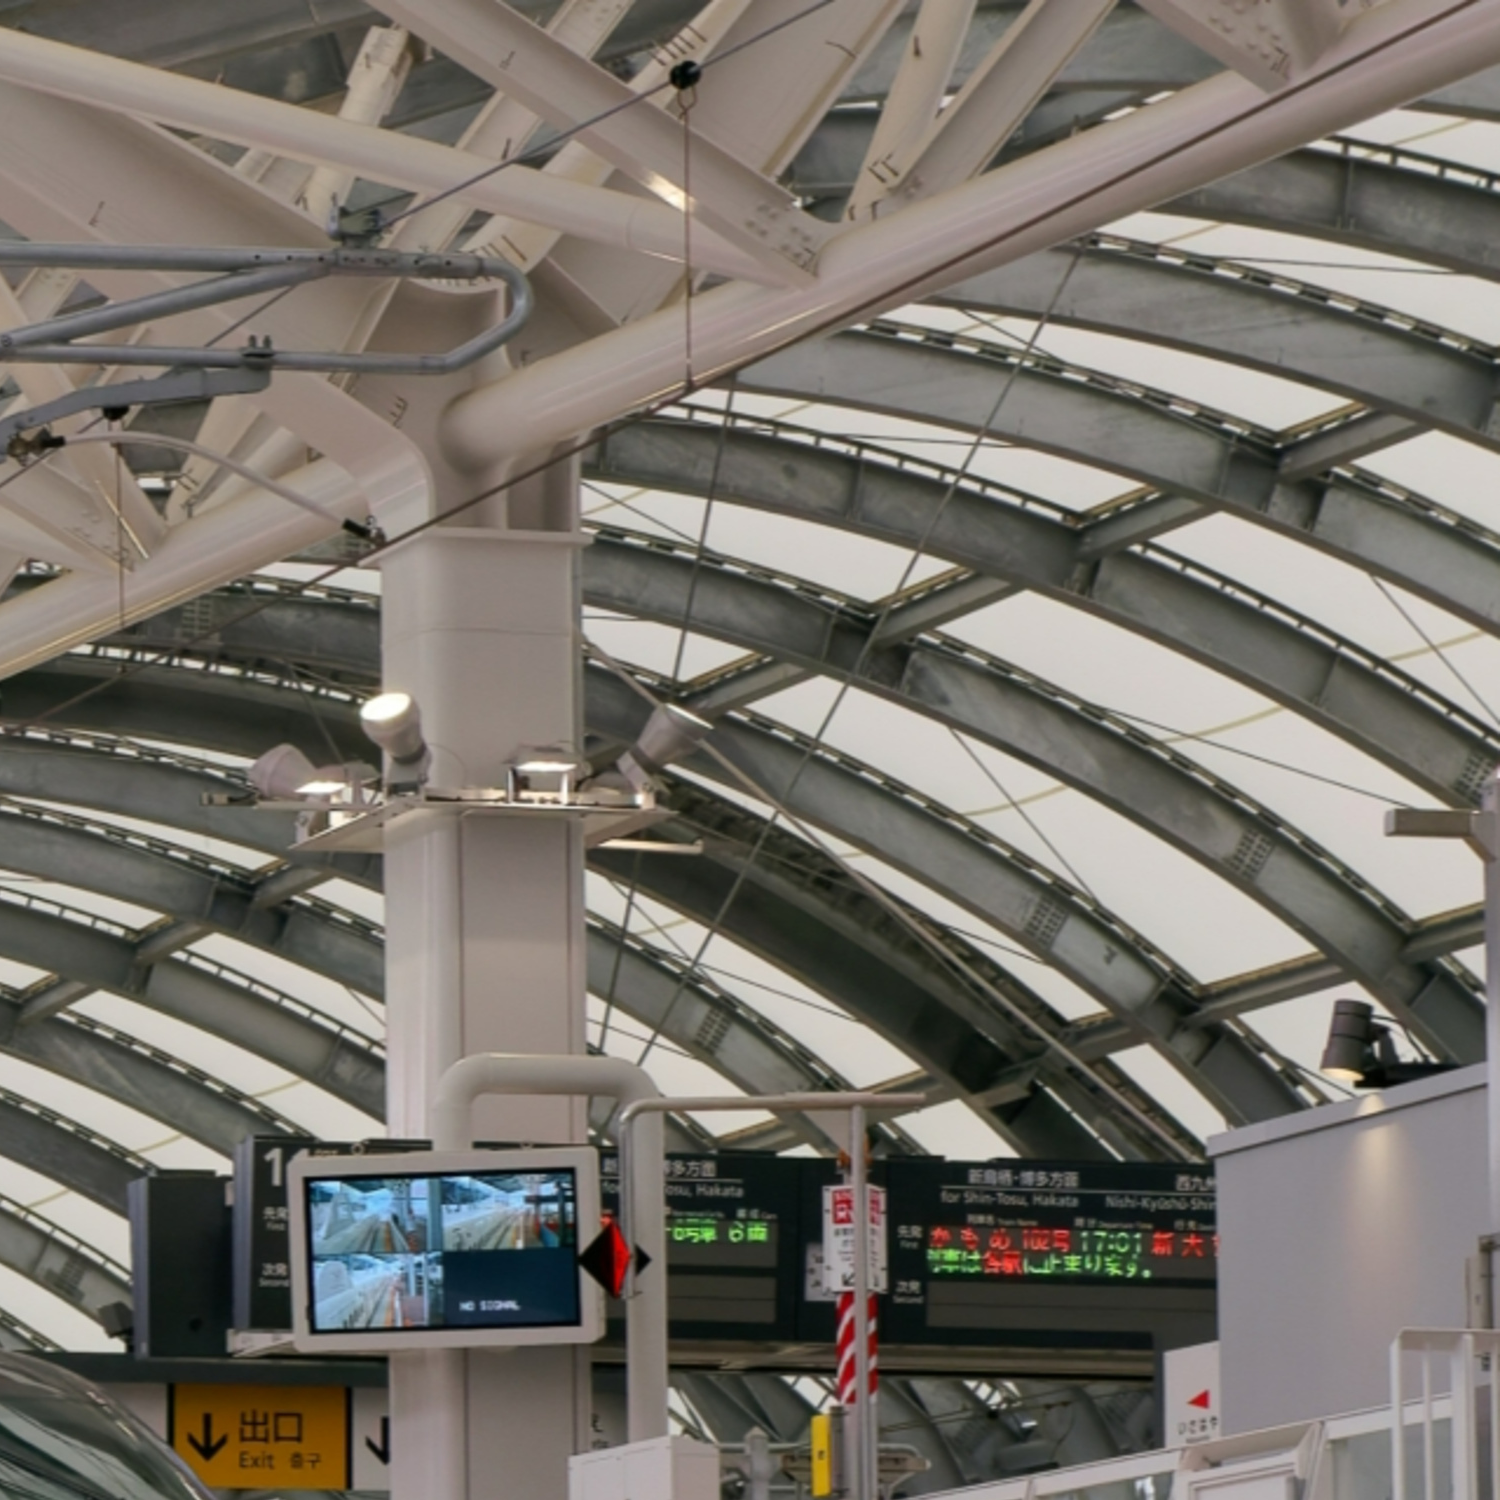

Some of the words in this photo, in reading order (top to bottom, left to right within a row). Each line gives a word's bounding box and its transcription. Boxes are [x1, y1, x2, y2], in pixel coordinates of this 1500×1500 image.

[1032, 1194, 1080, 1208] Hakata
[238, 1408, 304, 1444] 出口
[238, 1450, 275, 1470] Exit
